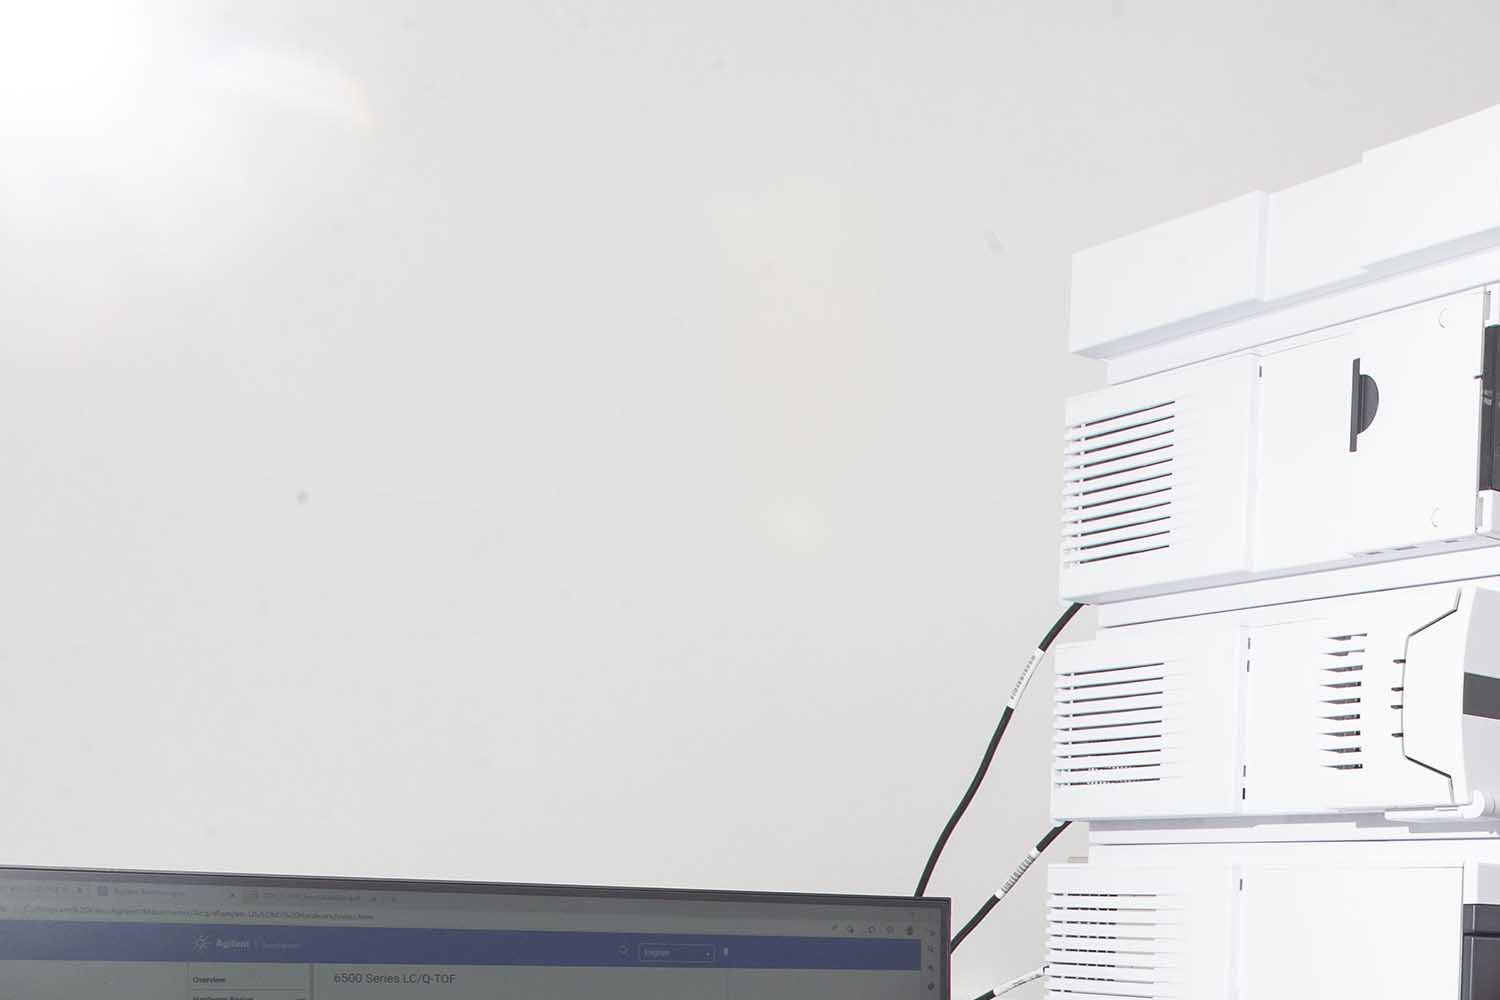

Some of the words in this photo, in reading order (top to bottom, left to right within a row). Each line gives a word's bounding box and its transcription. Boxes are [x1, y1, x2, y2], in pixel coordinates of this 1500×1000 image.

[333, 973, 363, 985] 6500
[365, 973, 400, 985] Series
[403, 973, 456, 985] LC/Q-TOF
